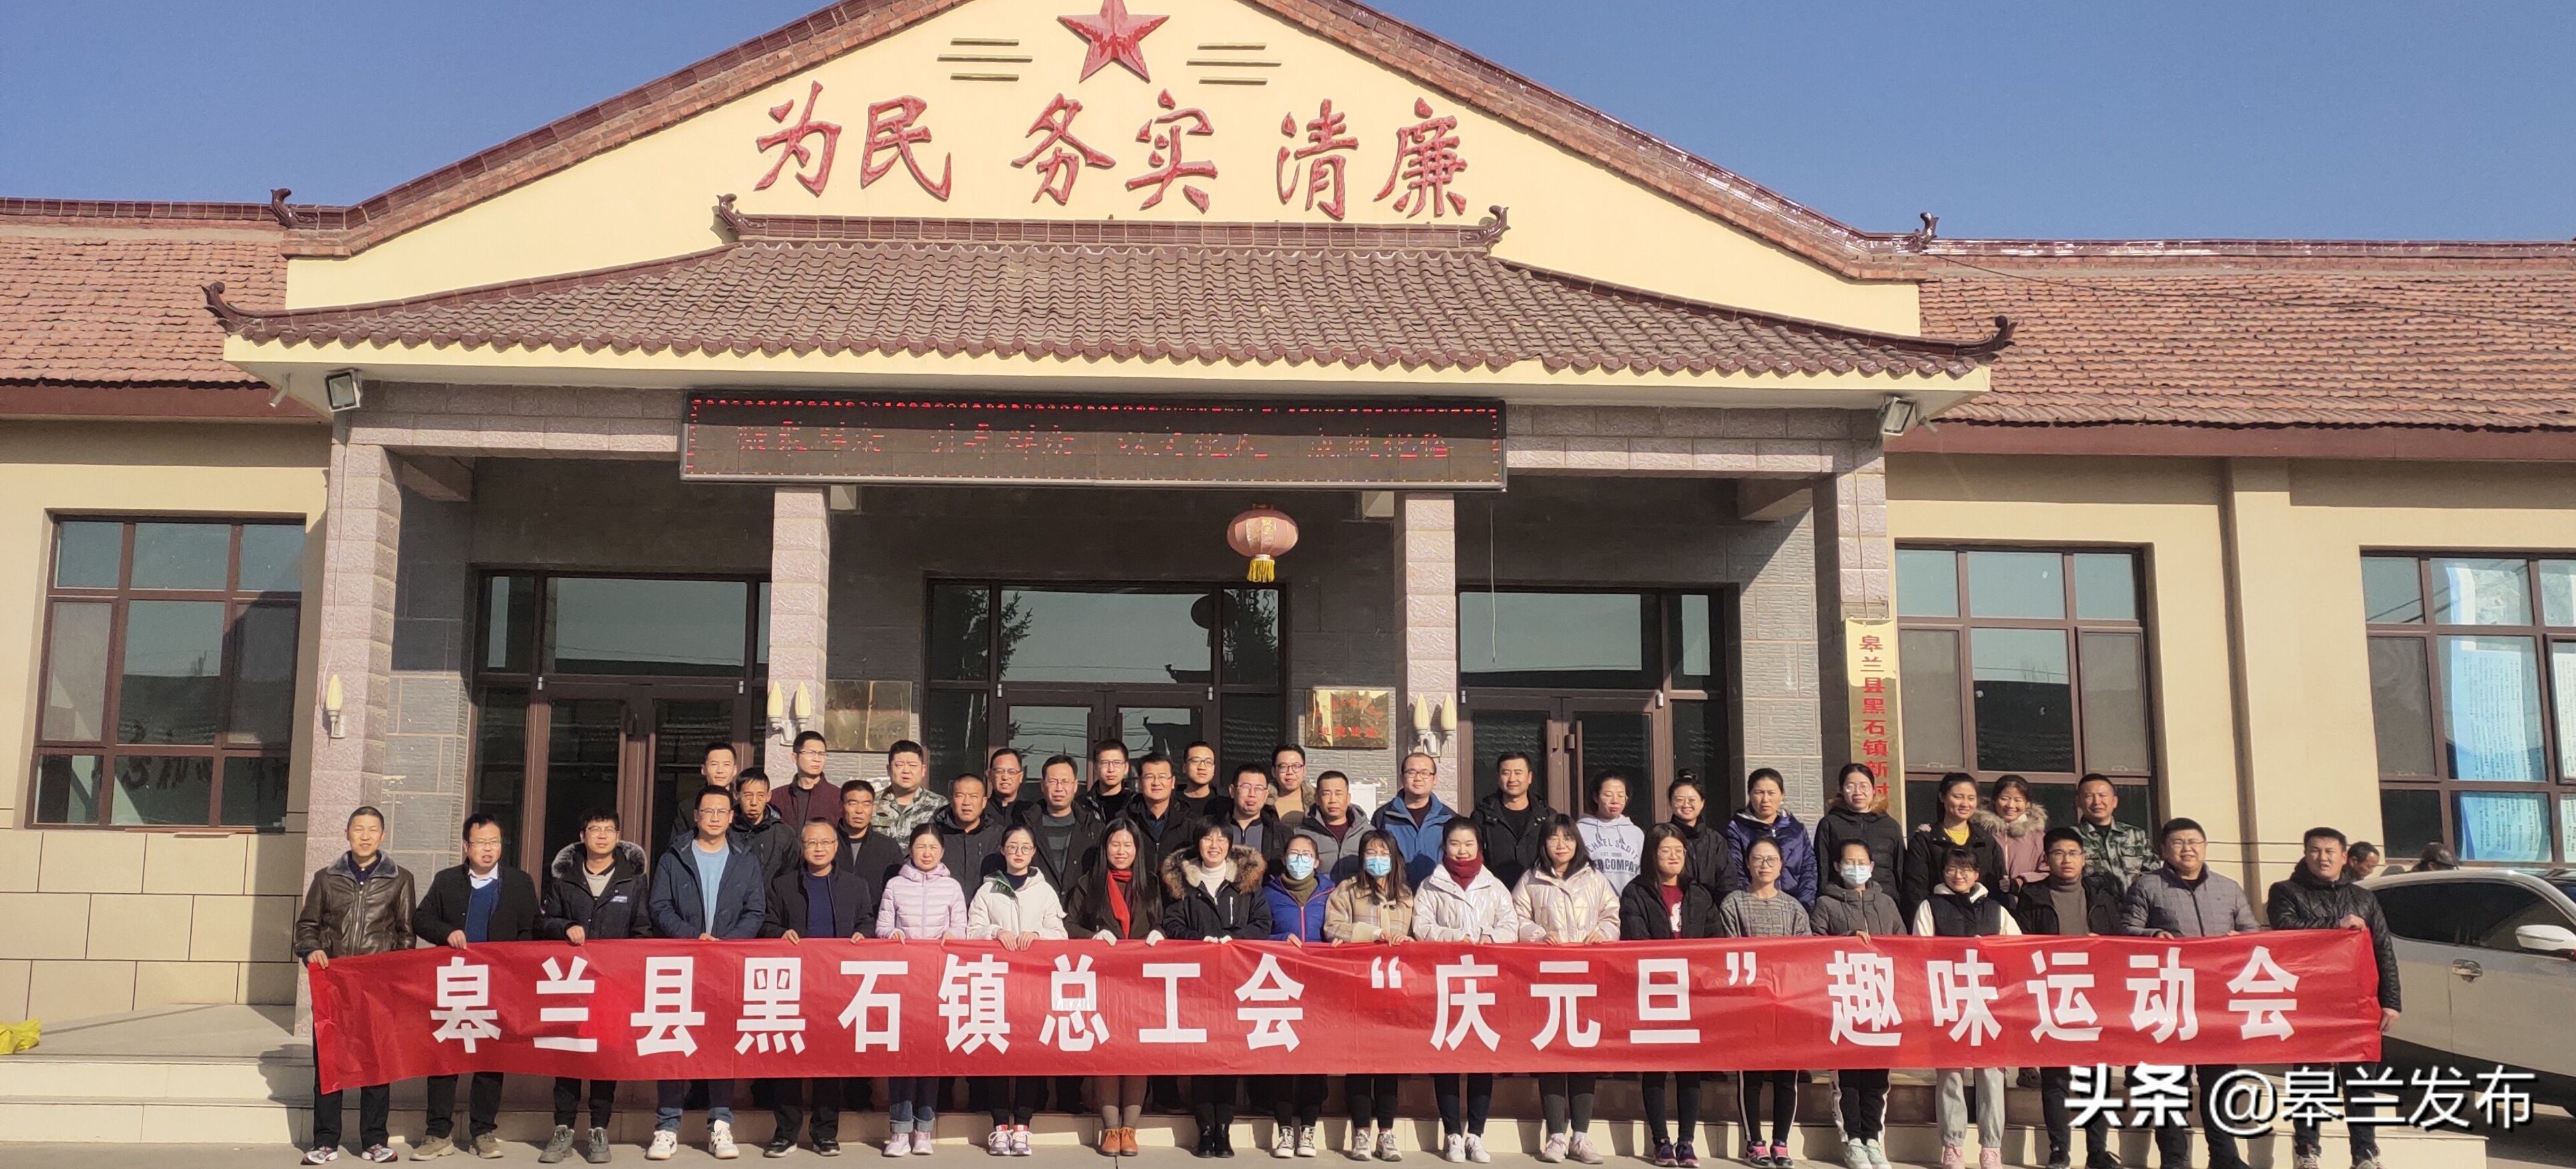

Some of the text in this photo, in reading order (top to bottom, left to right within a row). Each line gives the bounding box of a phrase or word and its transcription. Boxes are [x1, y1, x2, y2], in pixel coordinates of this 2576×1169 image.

[754, 80, 1468, 220] 为民 务实 清廉
